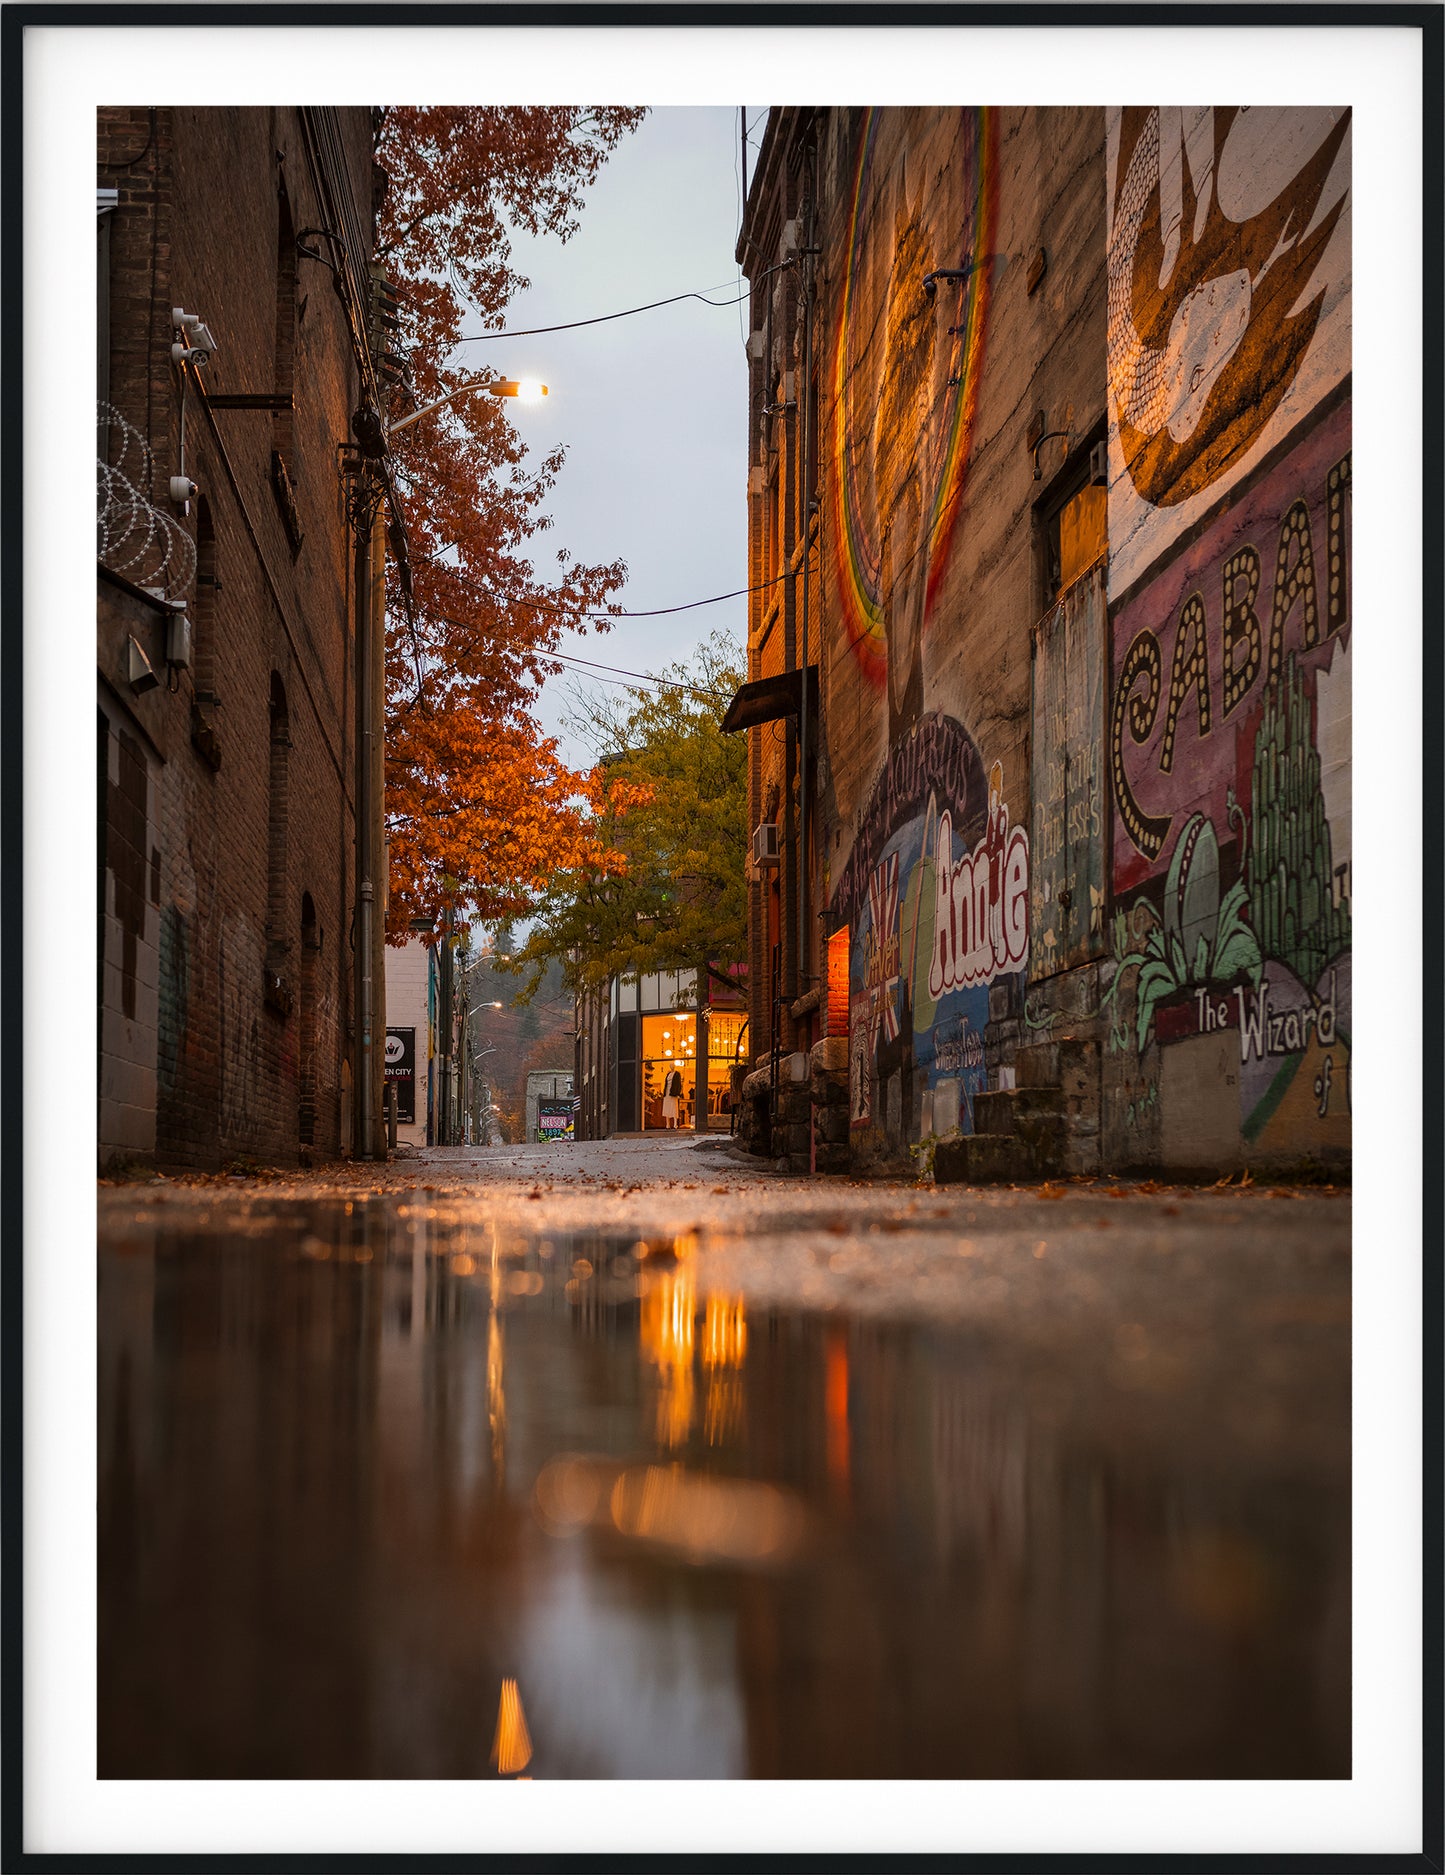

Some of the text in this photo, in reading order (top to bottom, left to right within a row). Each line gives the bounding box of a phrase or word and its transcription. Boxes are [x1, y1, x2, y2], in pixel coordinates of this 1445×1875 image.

[929, 808, 1030, 1001] Annie
[1195, 966, 1337, 1062] The Wizard
[541, 1117, 566, 1127] NELSON
[1314, 1055, 1333, 1117] of
